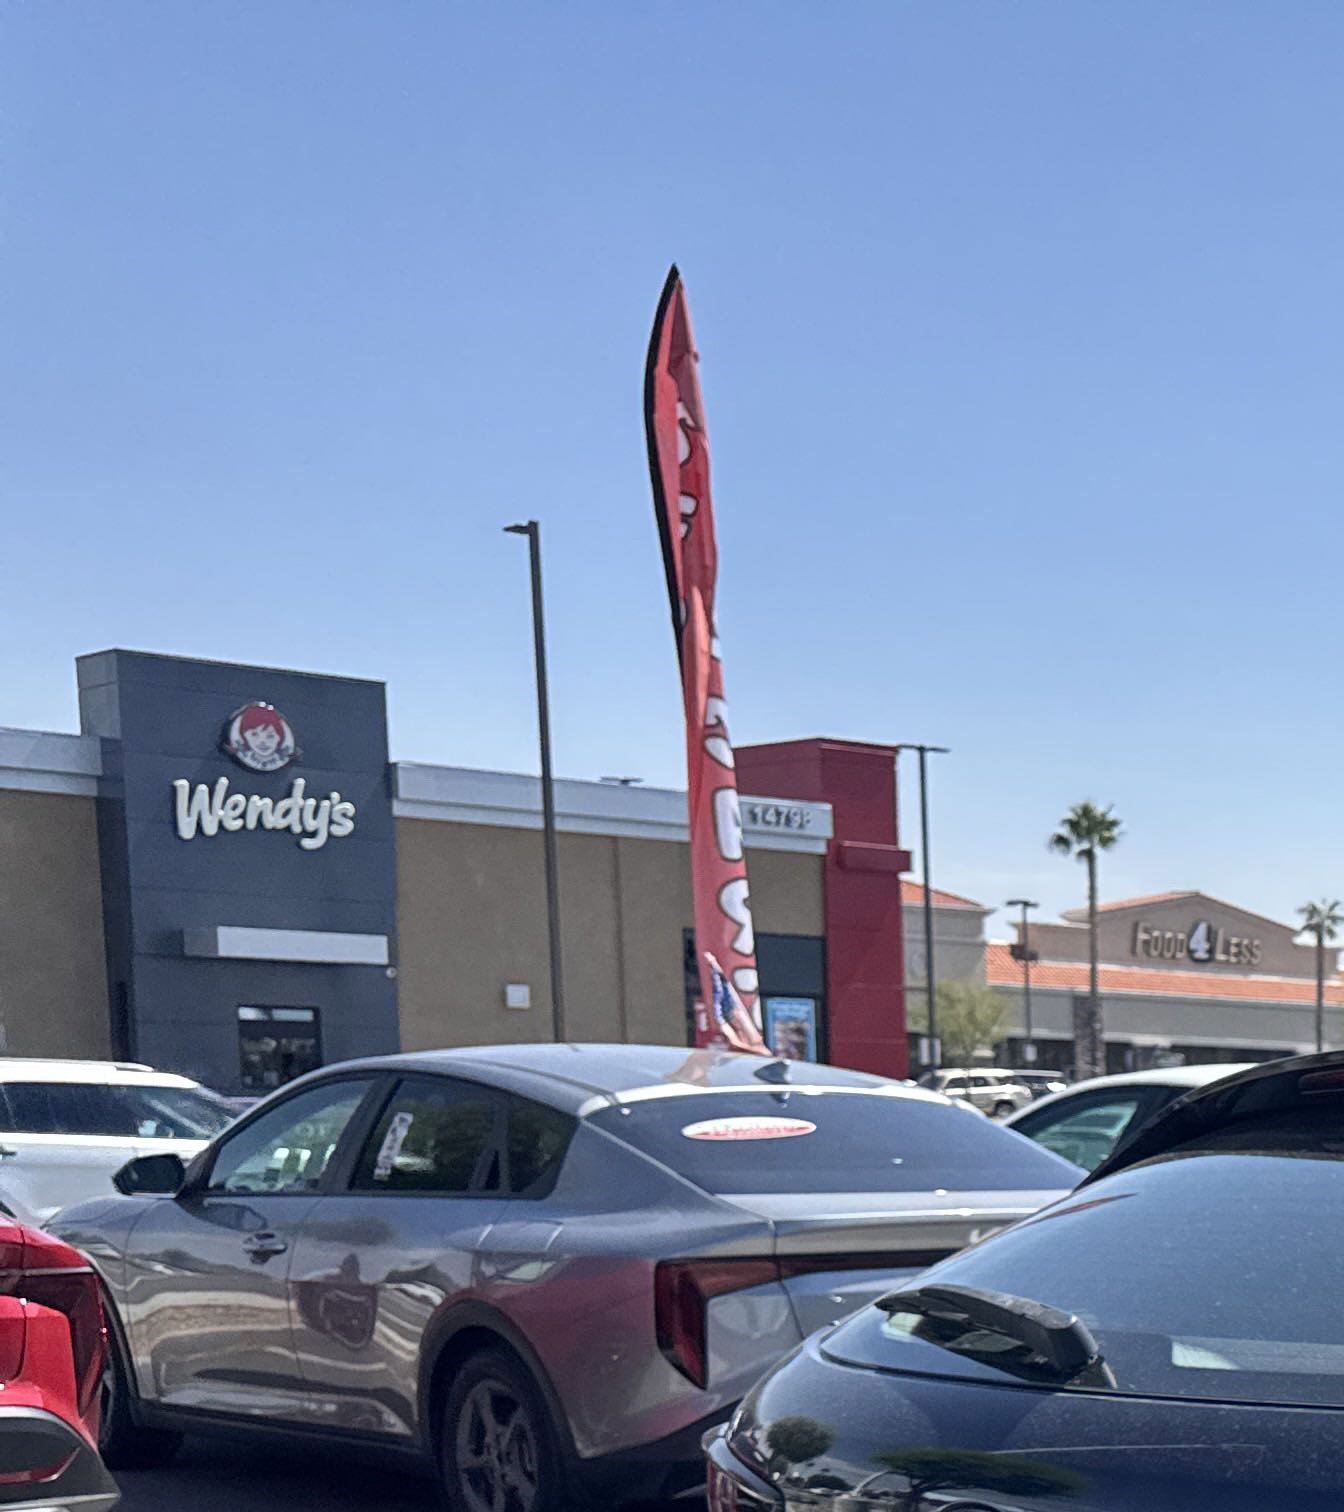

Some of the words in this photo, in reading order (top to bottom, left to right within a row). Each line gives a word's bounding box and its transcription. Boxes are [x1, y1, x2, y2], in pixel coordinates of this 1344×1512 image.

[173, 776, 356, 850] Wendy's
[1136, 921, 1188, 959] FOOD
[1189, 921, 1211, 960] 4
[1214, 927, 1263, 965] LESS
